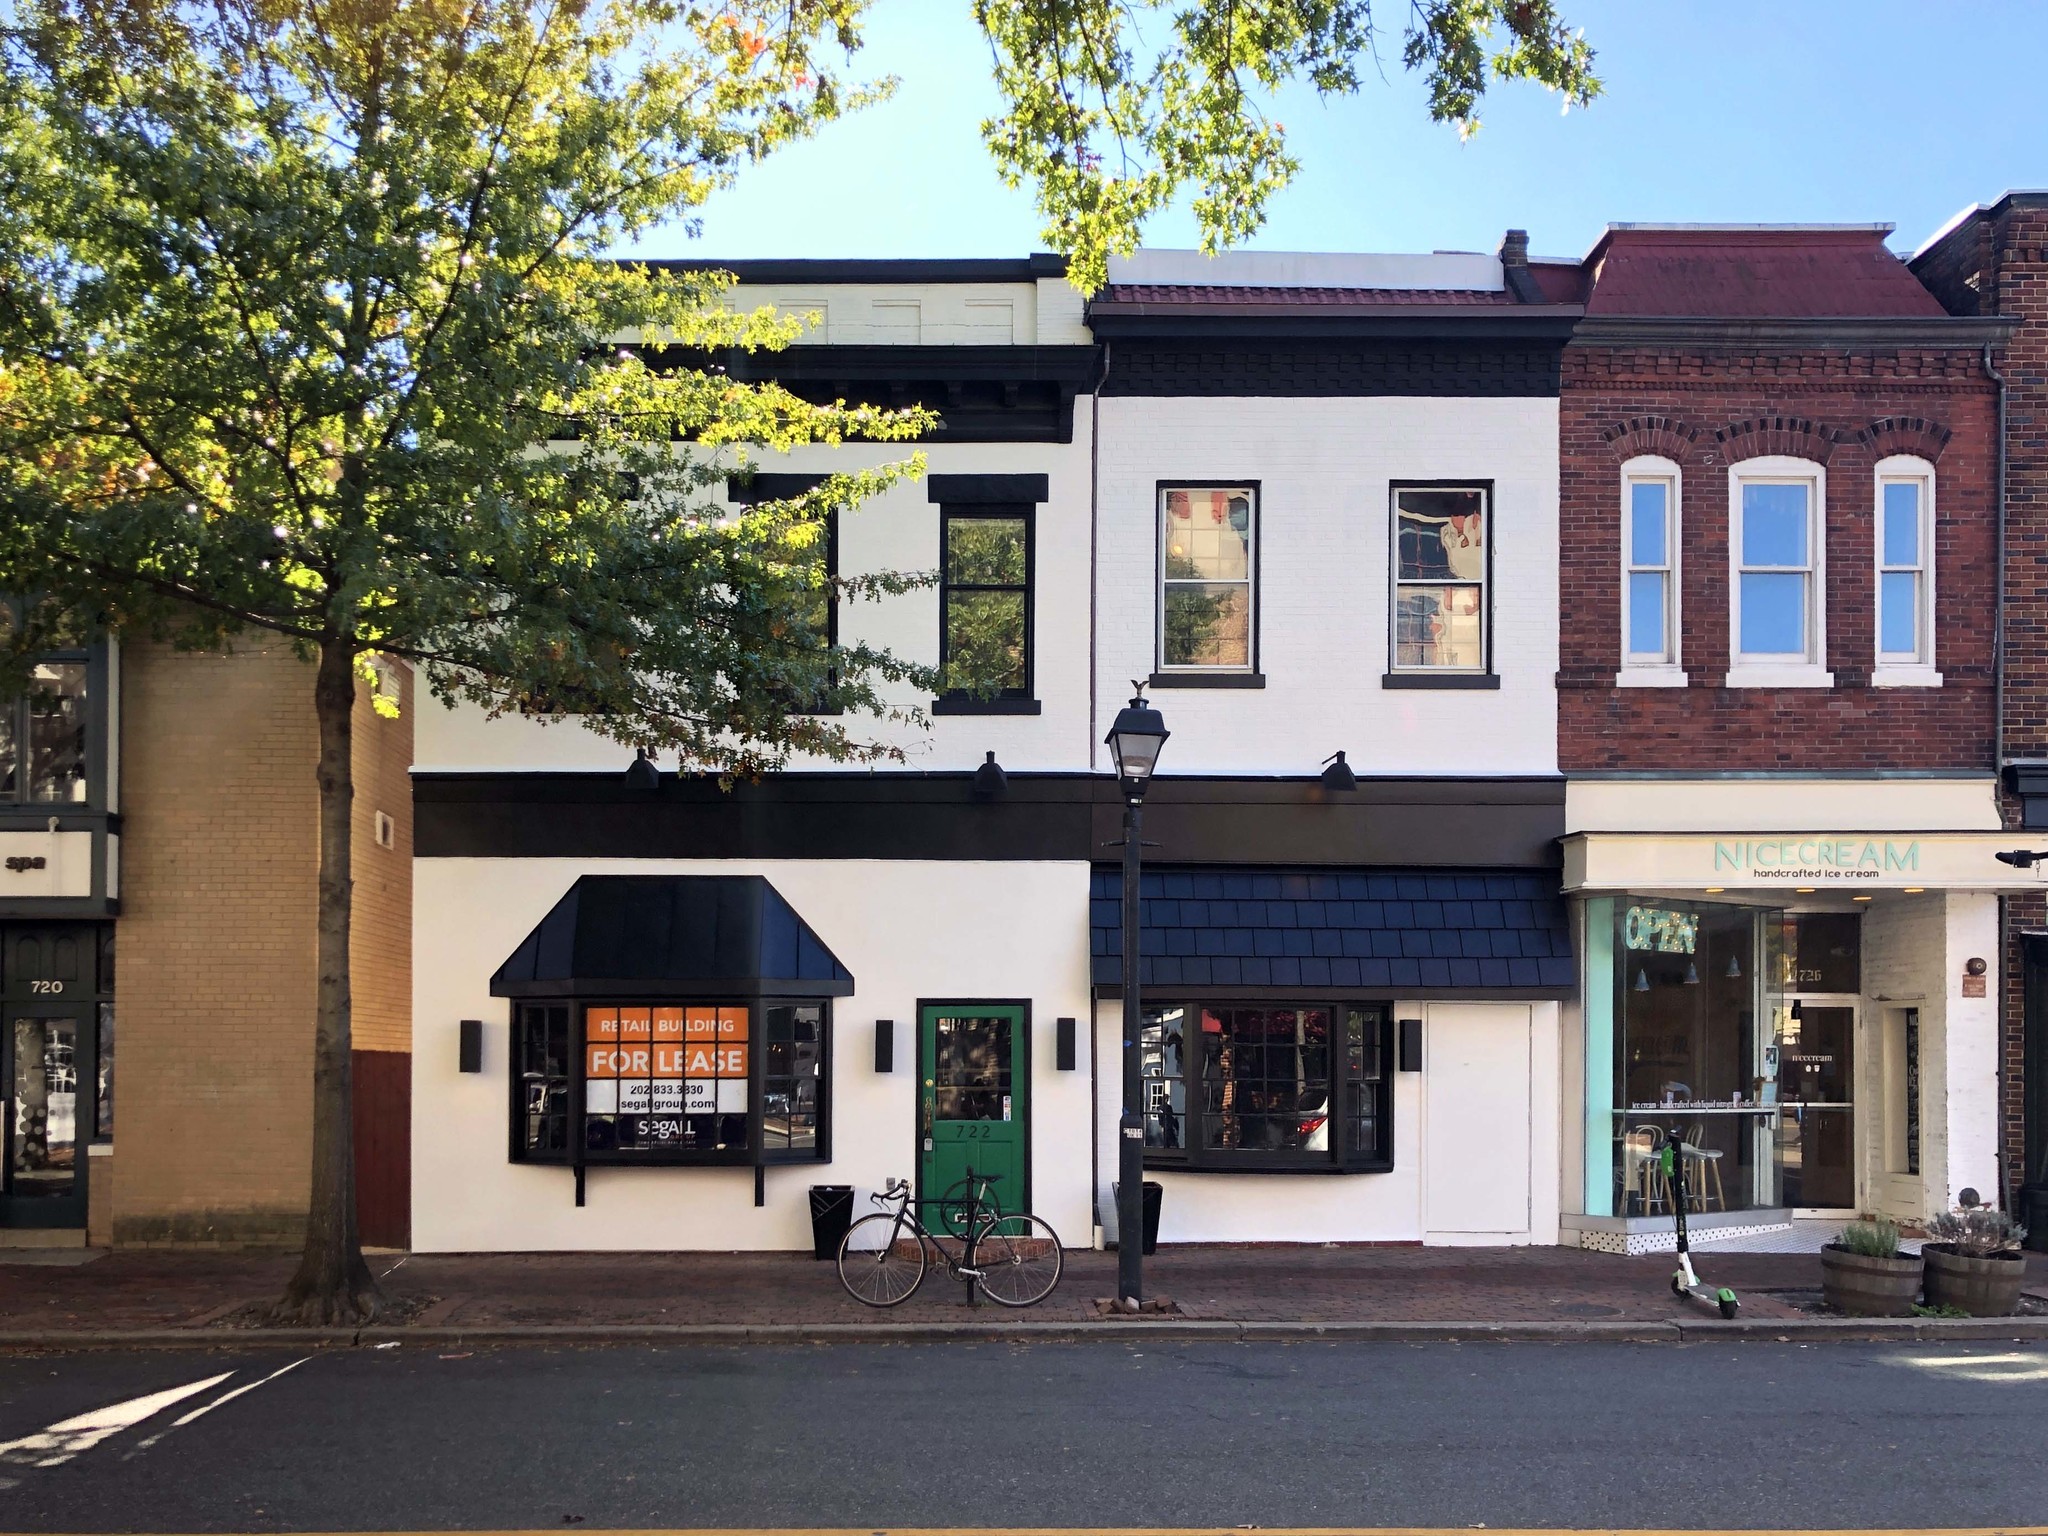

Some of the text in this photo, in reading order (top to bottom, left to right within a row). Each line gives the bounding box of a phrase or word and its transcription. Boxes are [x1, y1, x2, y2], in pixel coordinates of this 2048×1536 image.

[1714, 840, 1920, 871] NICECREAM
[5, 856, 46, 873] spa
[1753, 869, 1879, 878] handcrafted ice cream
[1626, 906, 1699, 954] OPEN
[1799, 969, 1822, 981] 726
[31, 981, 63, 993] 720
[601, 1019, 735, 1032] RETAIL BUILDING
[592, 1050, 743, 1073] FOR LEASE
[630, 1085, 704, 1095] 202833.3830
[956, 1125, 991, 1138] 722
